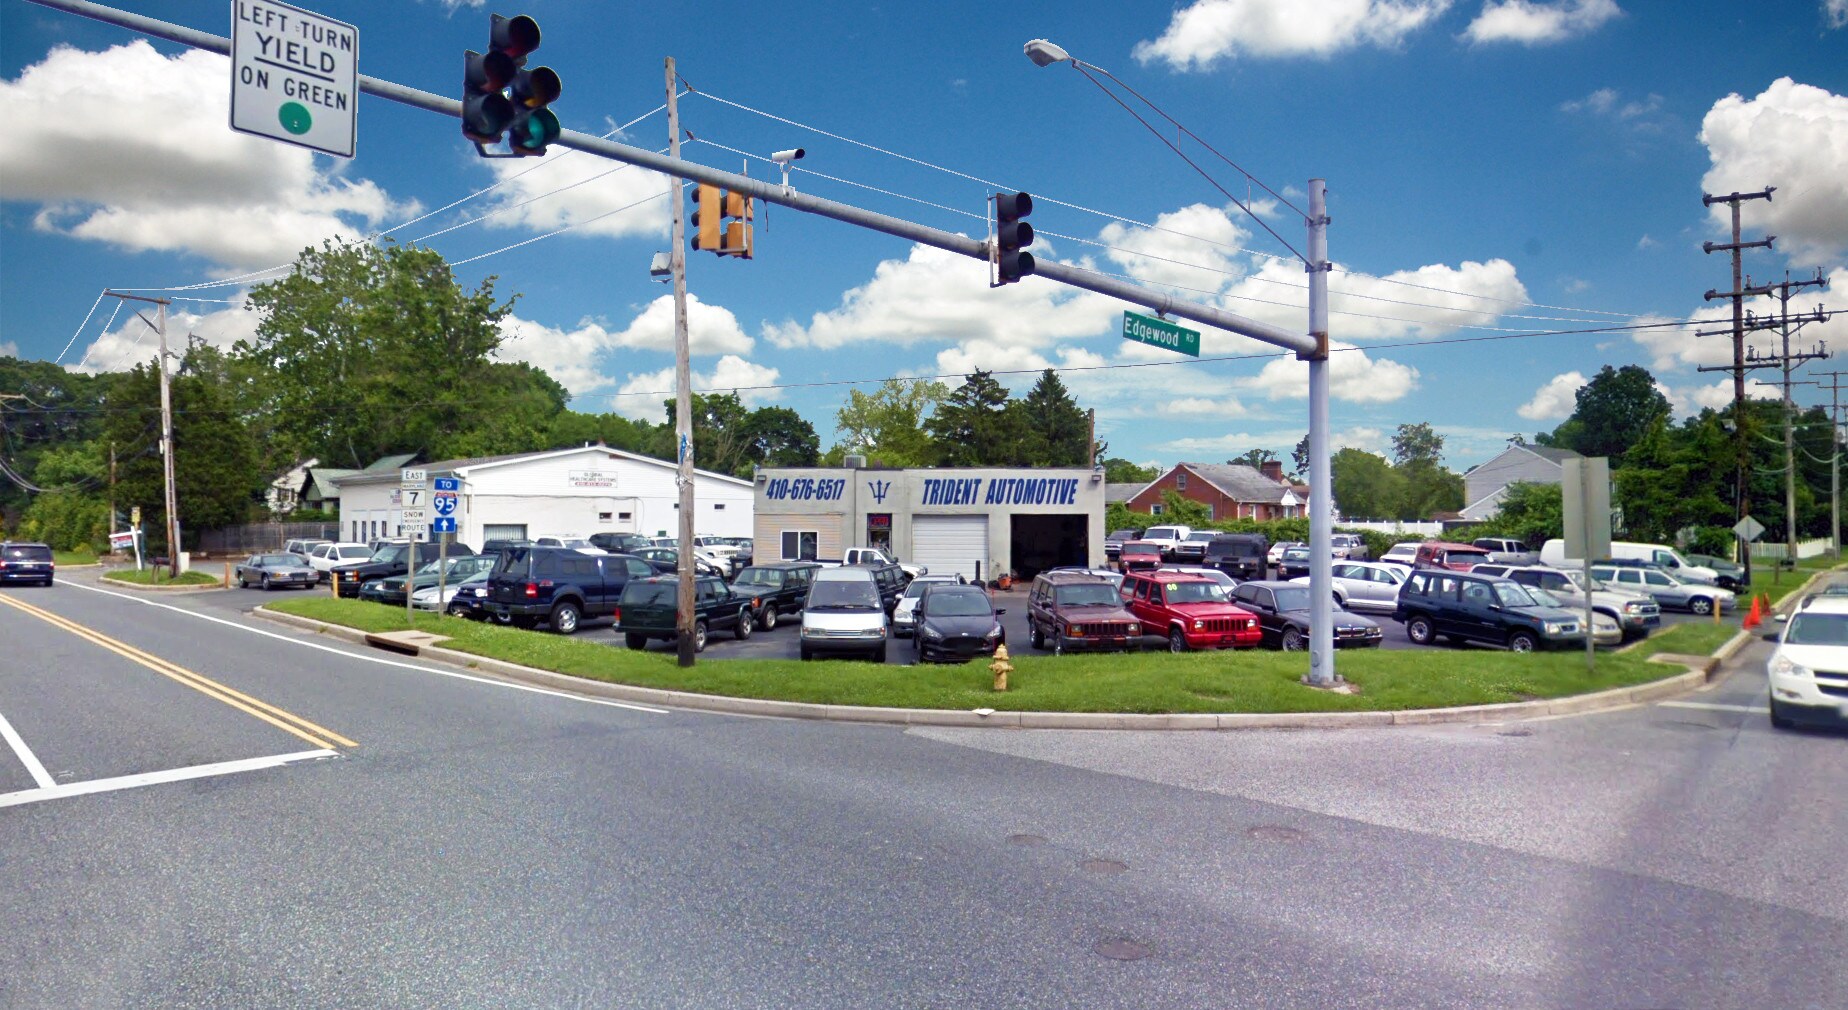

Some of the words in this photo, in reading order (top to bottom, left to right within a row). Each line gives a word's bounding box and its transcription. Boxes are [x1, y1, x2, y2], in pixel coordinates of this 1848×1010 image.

[240, 2, 288, 32] LEFT
[300, 20, 351, 52] TURN
[255, 31, 335, 73] YIELD
[240, 65, 269, 90] ON
[284, 77, 347, 111] GREEN
[1124, 316, 1179, 347] Edgewood
[1185, 333, 1195, 343] RD
[406, 471, 423, 479] EAST
[409, 491, 419, 505] 7
[766, 478, 846, 501] 410-676-6517
[922, 478, 982, 506] TRIDENT
[984, 478, 1079, 505] AUTOMOTIVE
[435, 498, 454, 511] 95
